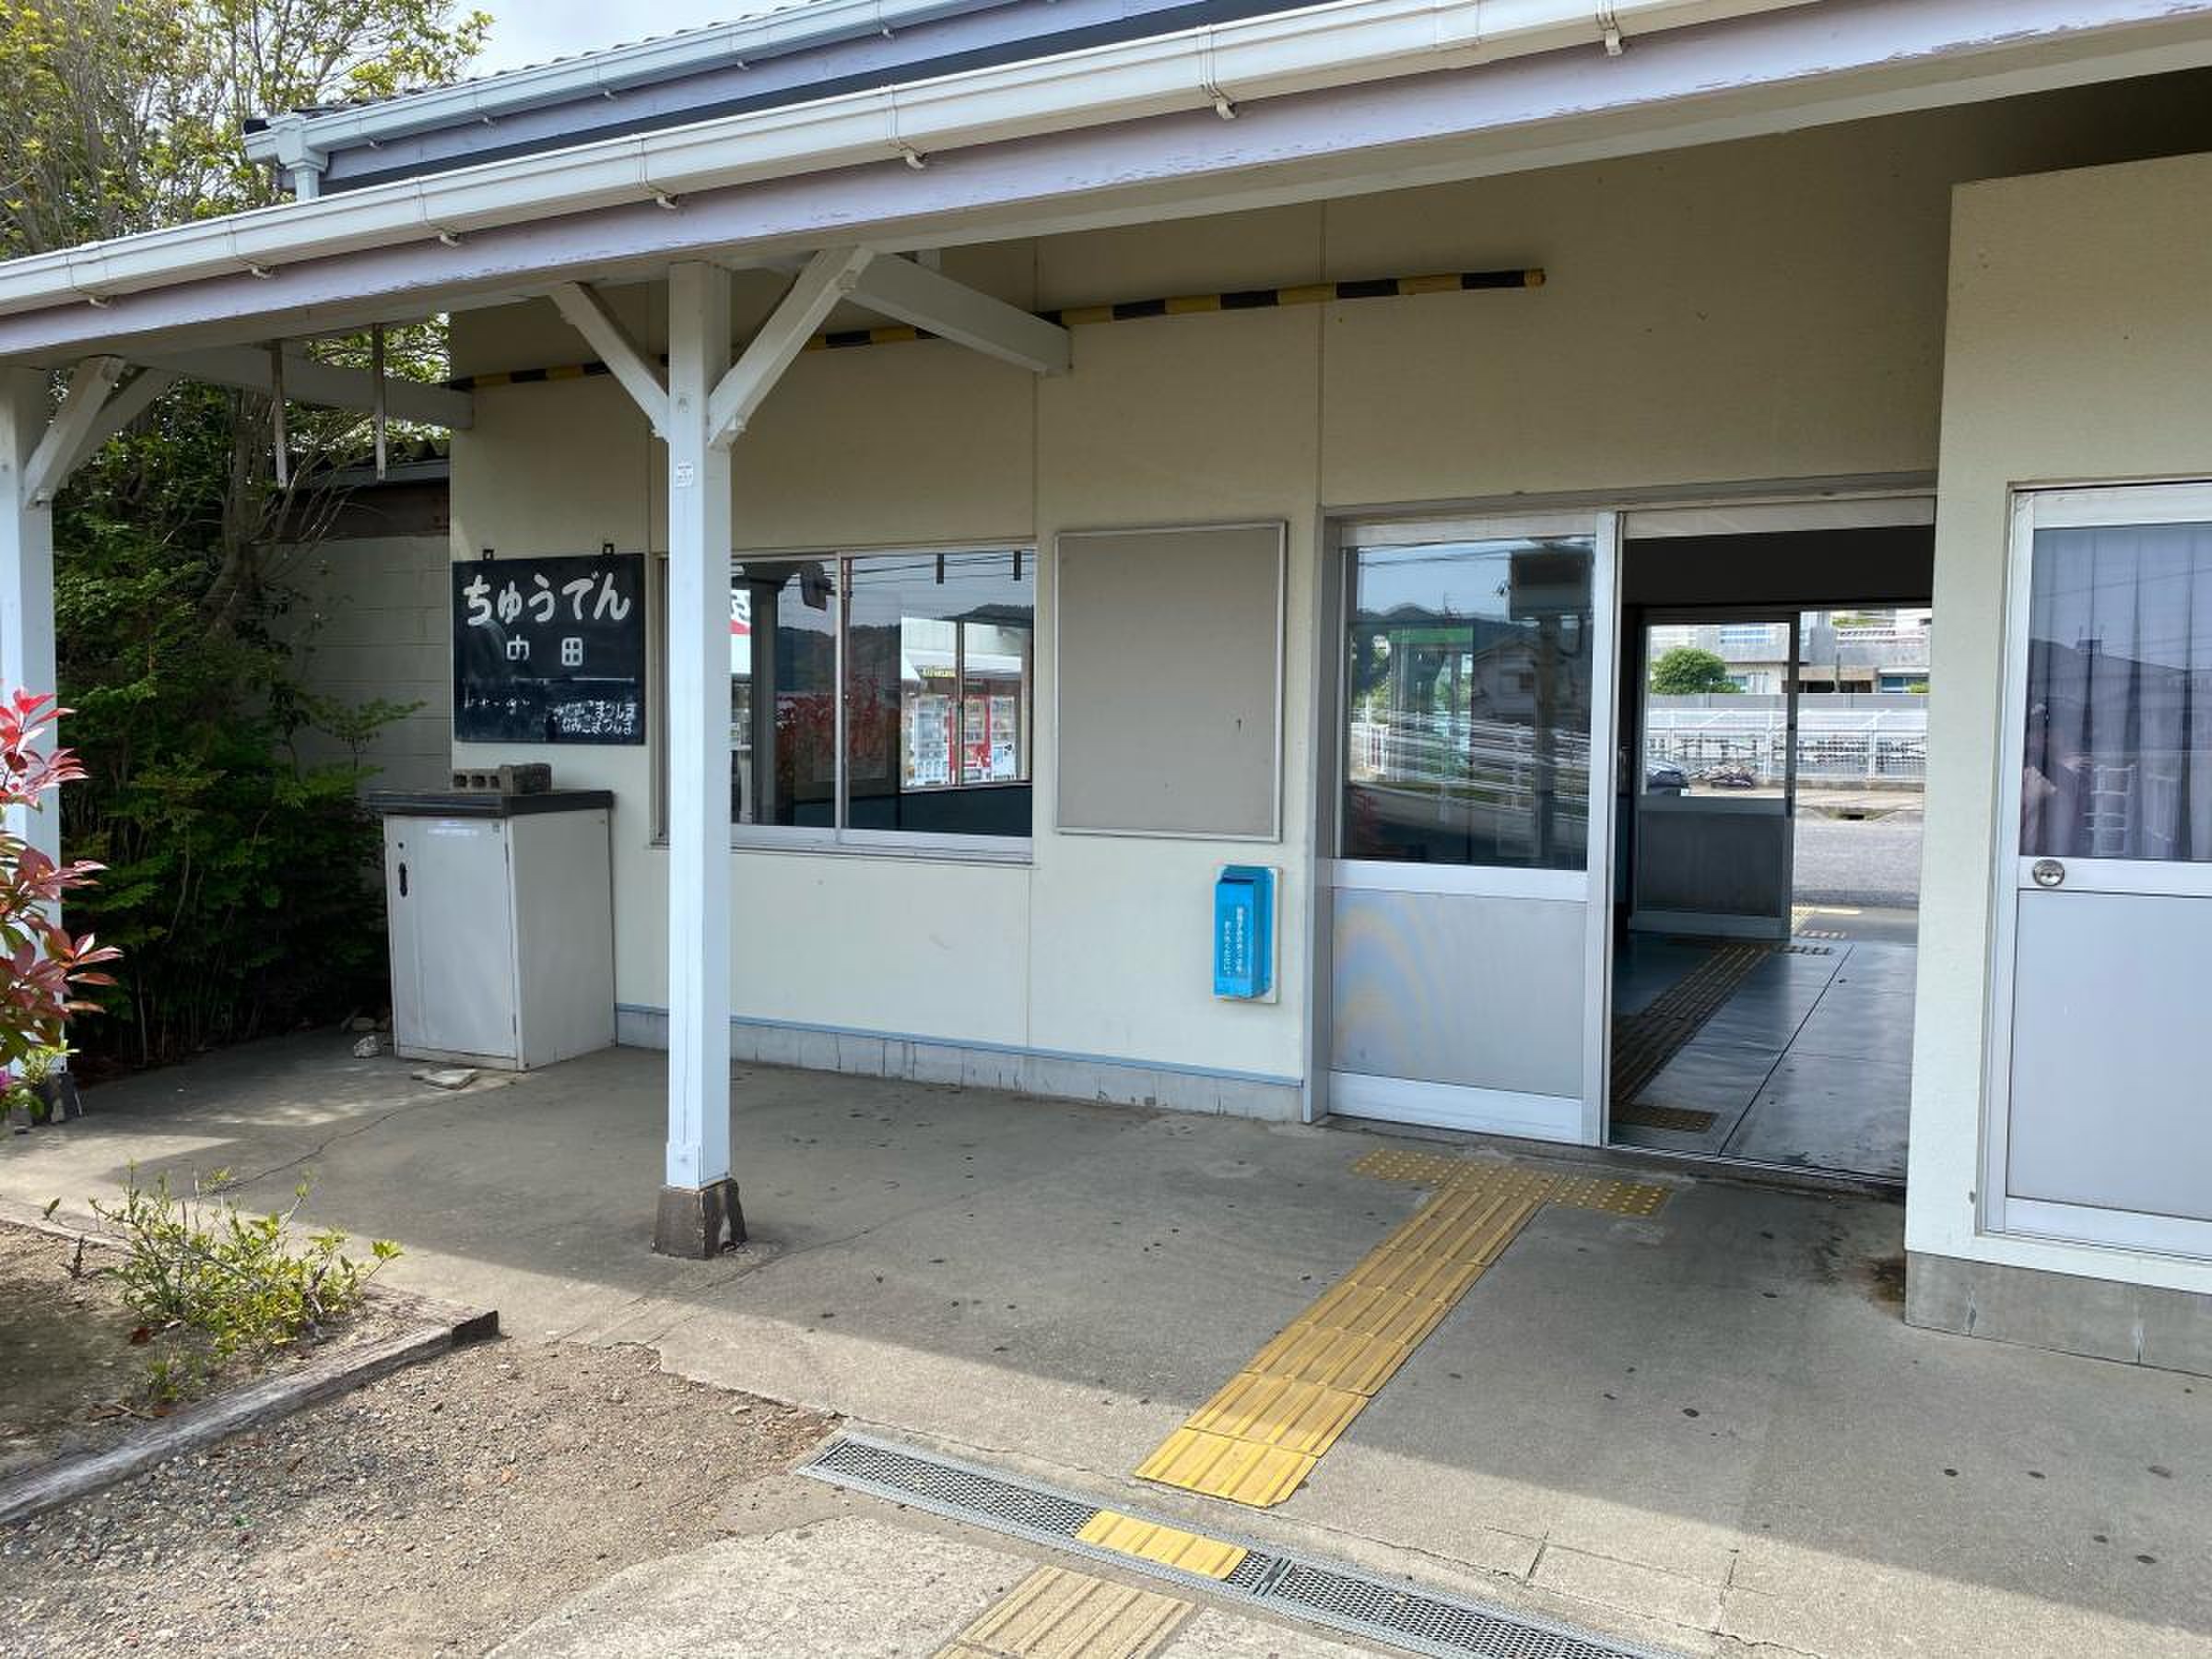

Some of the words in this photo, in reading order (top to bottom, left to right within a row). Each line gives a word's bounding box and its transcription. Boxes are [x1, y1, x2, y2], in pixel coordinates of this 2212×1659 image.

[463, 571, 631, 627] ちゅうでん
